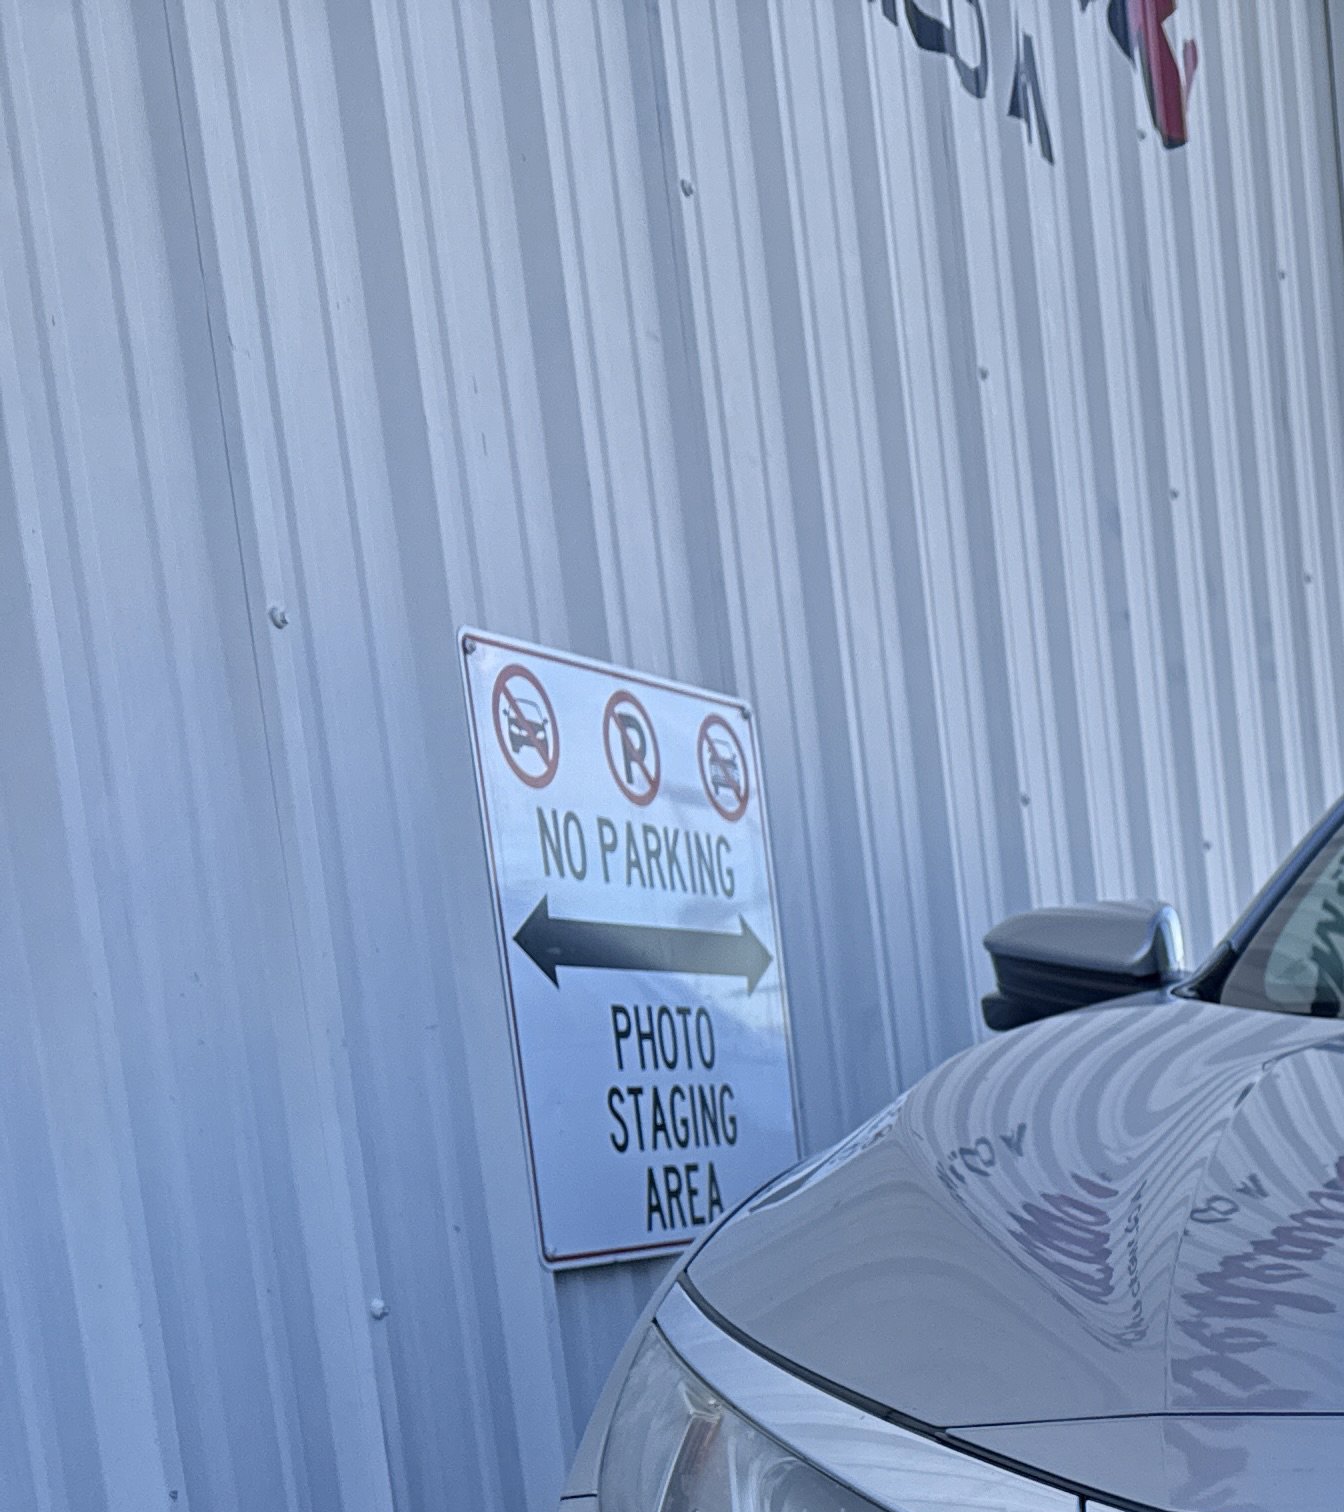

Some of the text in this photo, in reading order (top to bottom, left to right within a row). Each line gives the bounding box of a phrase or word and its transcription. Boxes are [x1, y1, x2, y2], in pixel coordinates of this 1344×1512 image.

[536, 806, 735, 898] NO PARKING
[611, 1004, 715, 1072] PHOTO
[607, 1083, 738, 1153] STAGING
[647, 1161, 725, 1233] AREA
